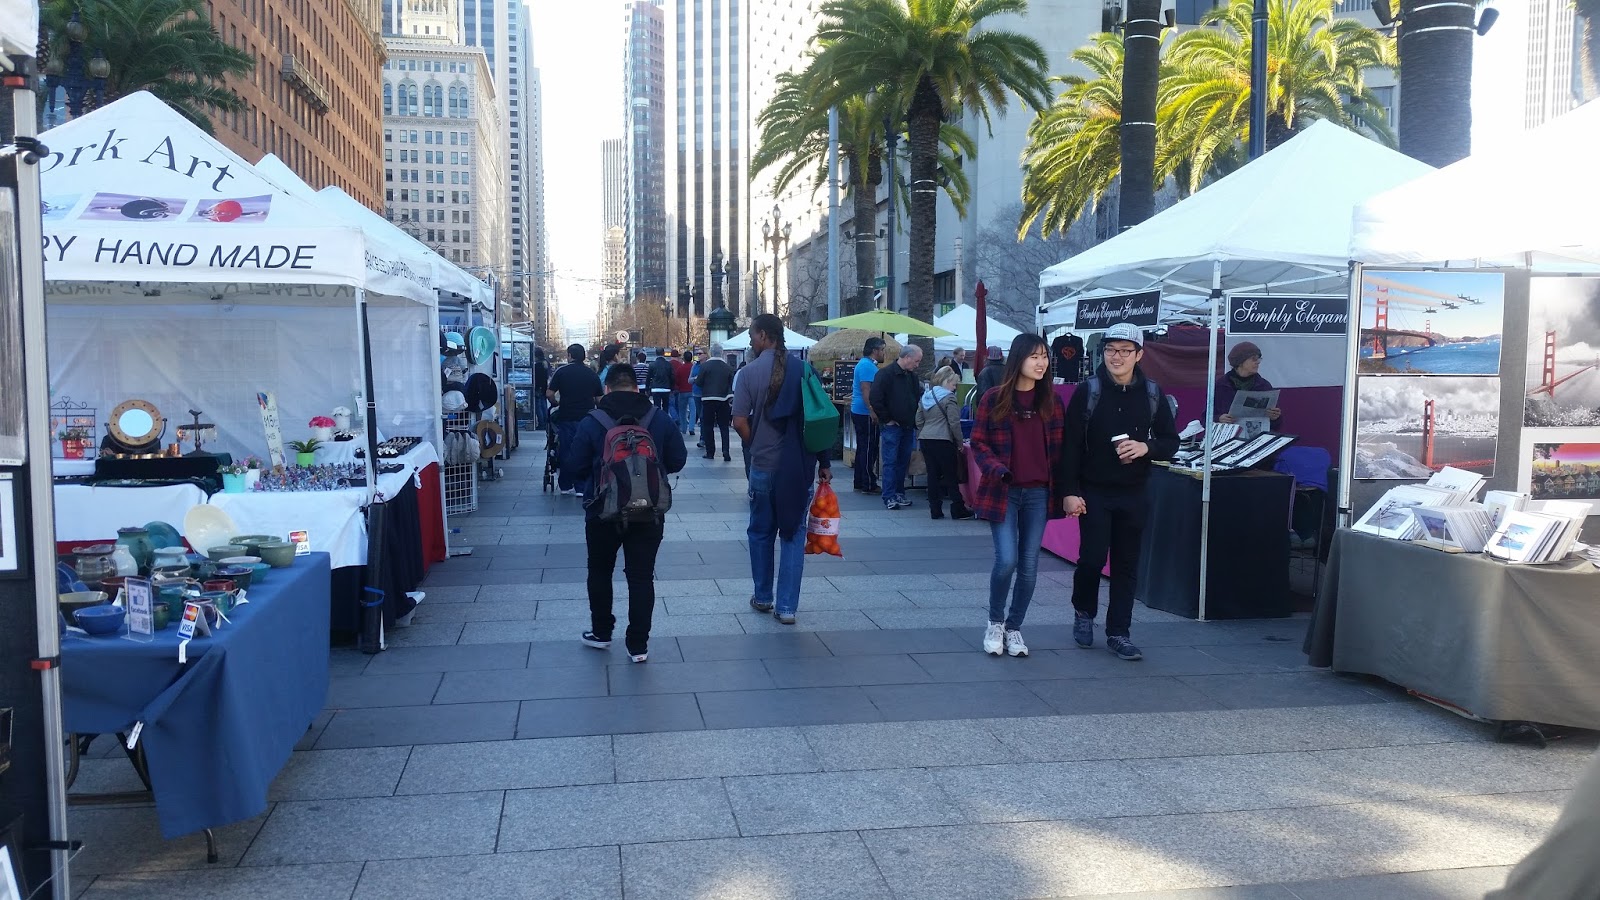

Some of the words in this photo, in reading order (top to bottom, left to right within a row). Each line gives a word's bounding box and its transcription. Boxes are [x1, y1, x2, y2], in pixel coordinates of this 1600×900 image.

[139, 135, 235, 193] Art
[94, 237, 199, 266] HAND
[208, 244, 317, 270] MADE
[1234, 299, 1293, 331] Simply
[181, 623, 193, 633] VISA
